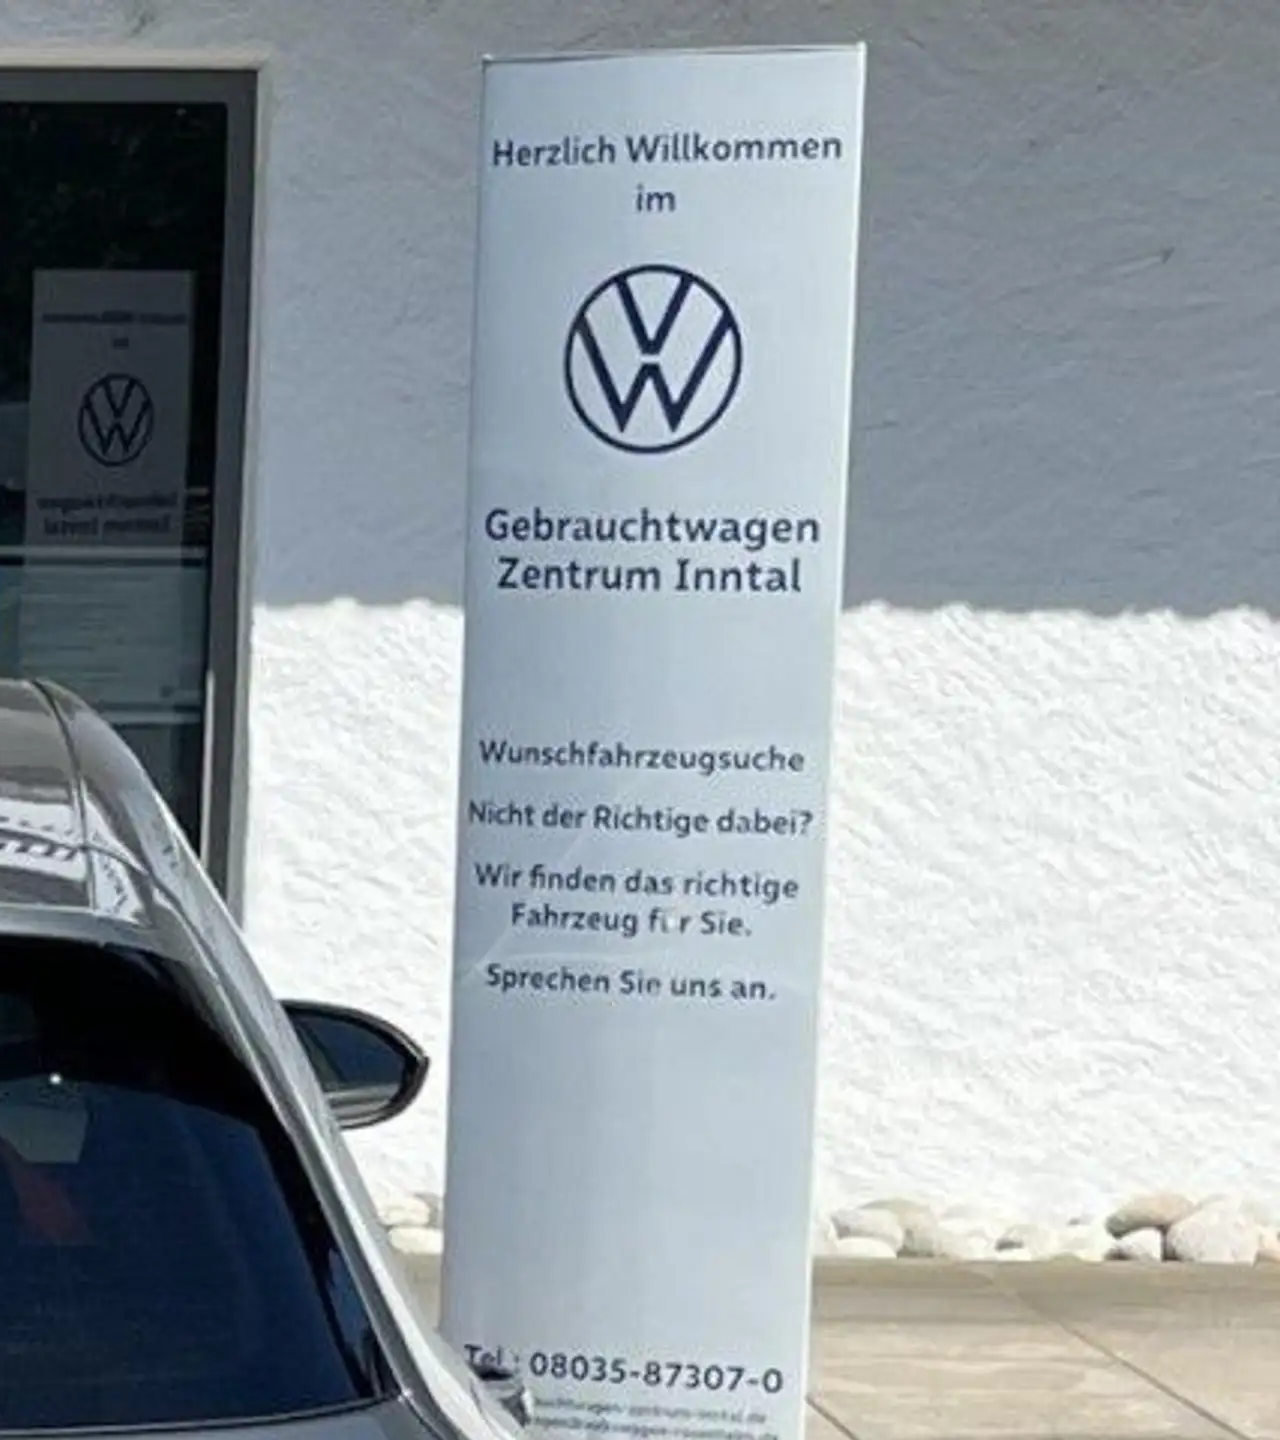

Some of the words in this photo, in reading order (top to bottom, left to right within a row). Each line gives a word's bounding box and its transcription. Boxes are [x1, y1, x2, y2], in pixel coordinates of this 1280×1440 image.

[492, 137, 616, 167] Herzlich
[626, 131, 843, 163] Willkommen
[635, 184, 677, 213] im
[484, 507, 821, 553] Gebrauchtwagen
[497, 557, 661, 592] Zentrum
[674, 558, 802, 593] Inntal
[479, 739, 805, 777] Wunschfahrzeugsuche
[467, 799, 535, 827] Nicht
[542, 802, 587, 831] der
[592, 804, 709, 838] Richtige
[716, 808, 814, 836] dabei?
[475, 863, 523, 889] Wir
[529, 864, 616, 893] finden
[624, 867, 674, 894] das
[683, 871, 800, 904] richtige
[511, 903, 639, 937] Fahrzeug
[700, 910, 753, 938] Sie.
[486, 963, 611, 994] Sprechen
[619, 969, 661, 995] Sie
[670, 974, 722, 999] uns
[729, 979, 777, 1001] an.
[529, 1351, 784, 1395] 08035-87307-0
